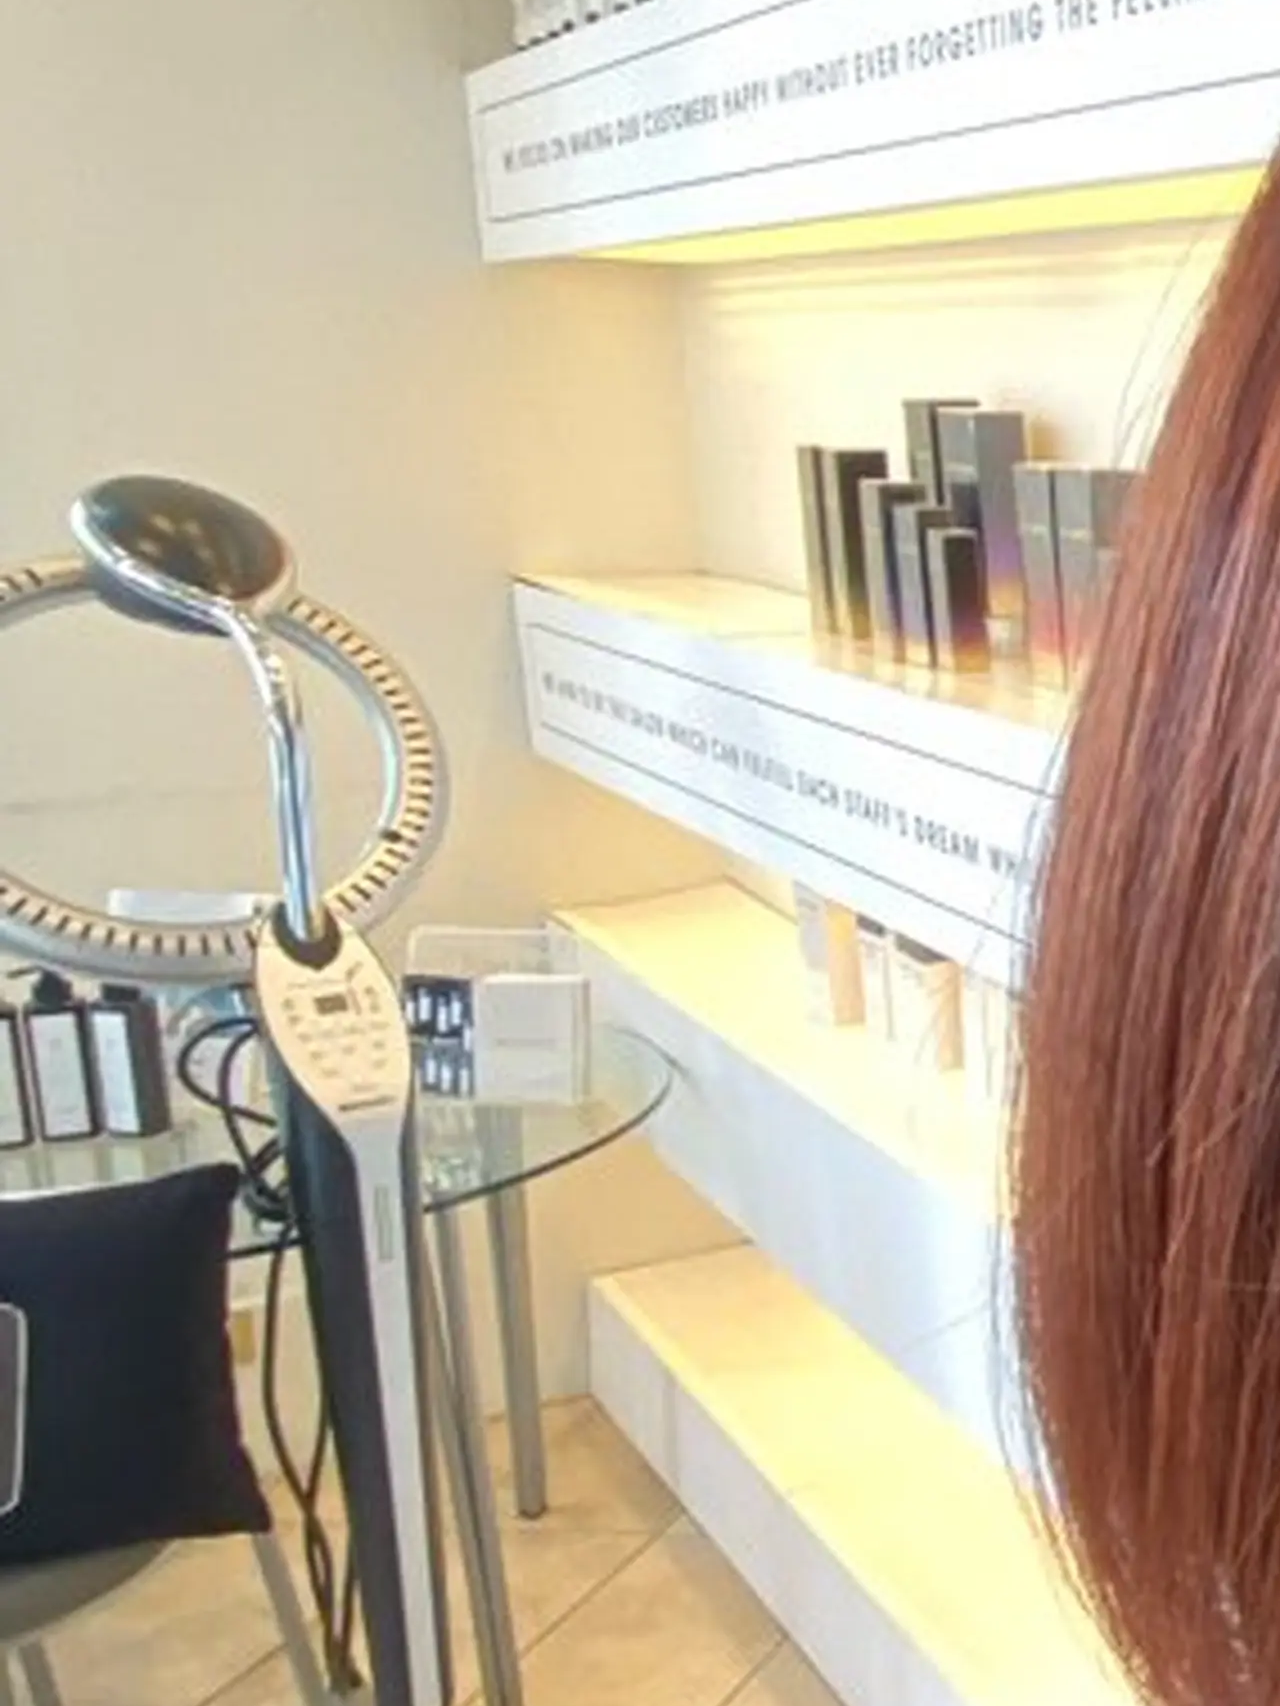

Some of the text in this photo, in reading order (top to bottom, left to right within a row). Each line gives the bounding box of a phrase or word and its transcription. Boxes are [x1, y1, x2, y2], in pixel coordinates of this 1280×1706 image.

[778, 53, 850, 103] WITHOUT
[854, 41, 900, 86] EVER
[905, 1, 1045, 72] FORGETTING
[913, 813, 980, 866] DREAM
